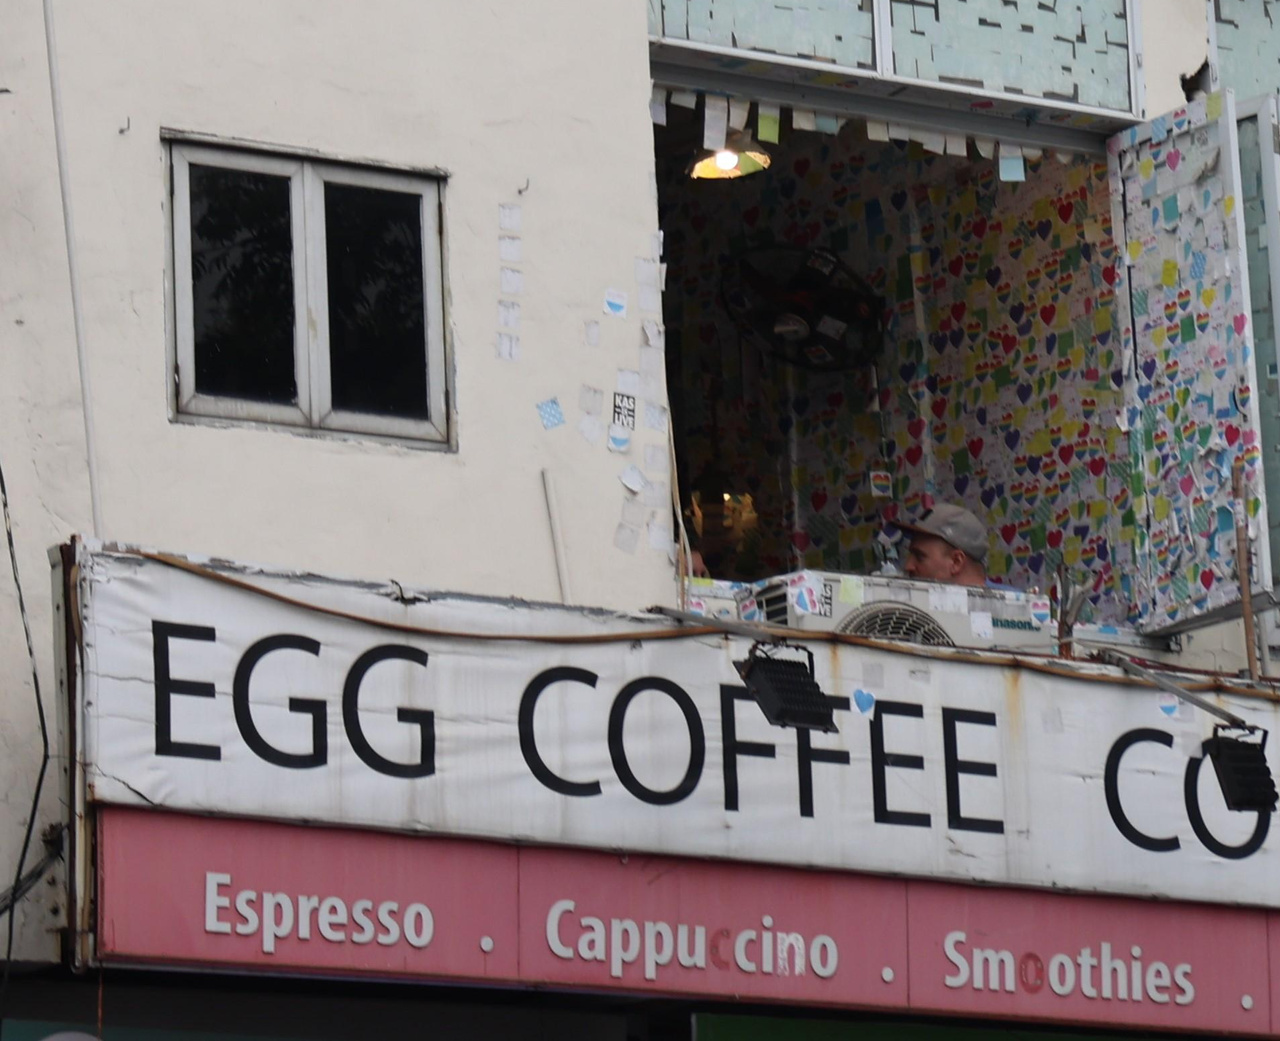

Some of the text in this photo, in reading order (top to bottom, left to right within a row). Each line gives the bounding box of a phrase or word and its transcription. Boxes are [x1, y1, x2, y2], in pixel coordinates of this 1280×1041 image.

[615, 393, 635, 410] KAS
[152, 620, 435, 778] EGG
[518, 667, 1005, 834] COFFEE
[204, 871, 434, 953] Espresso
[546, 899, 839, 980] Cappuccino
[944, 930, 1195, 1005] Smoothies
